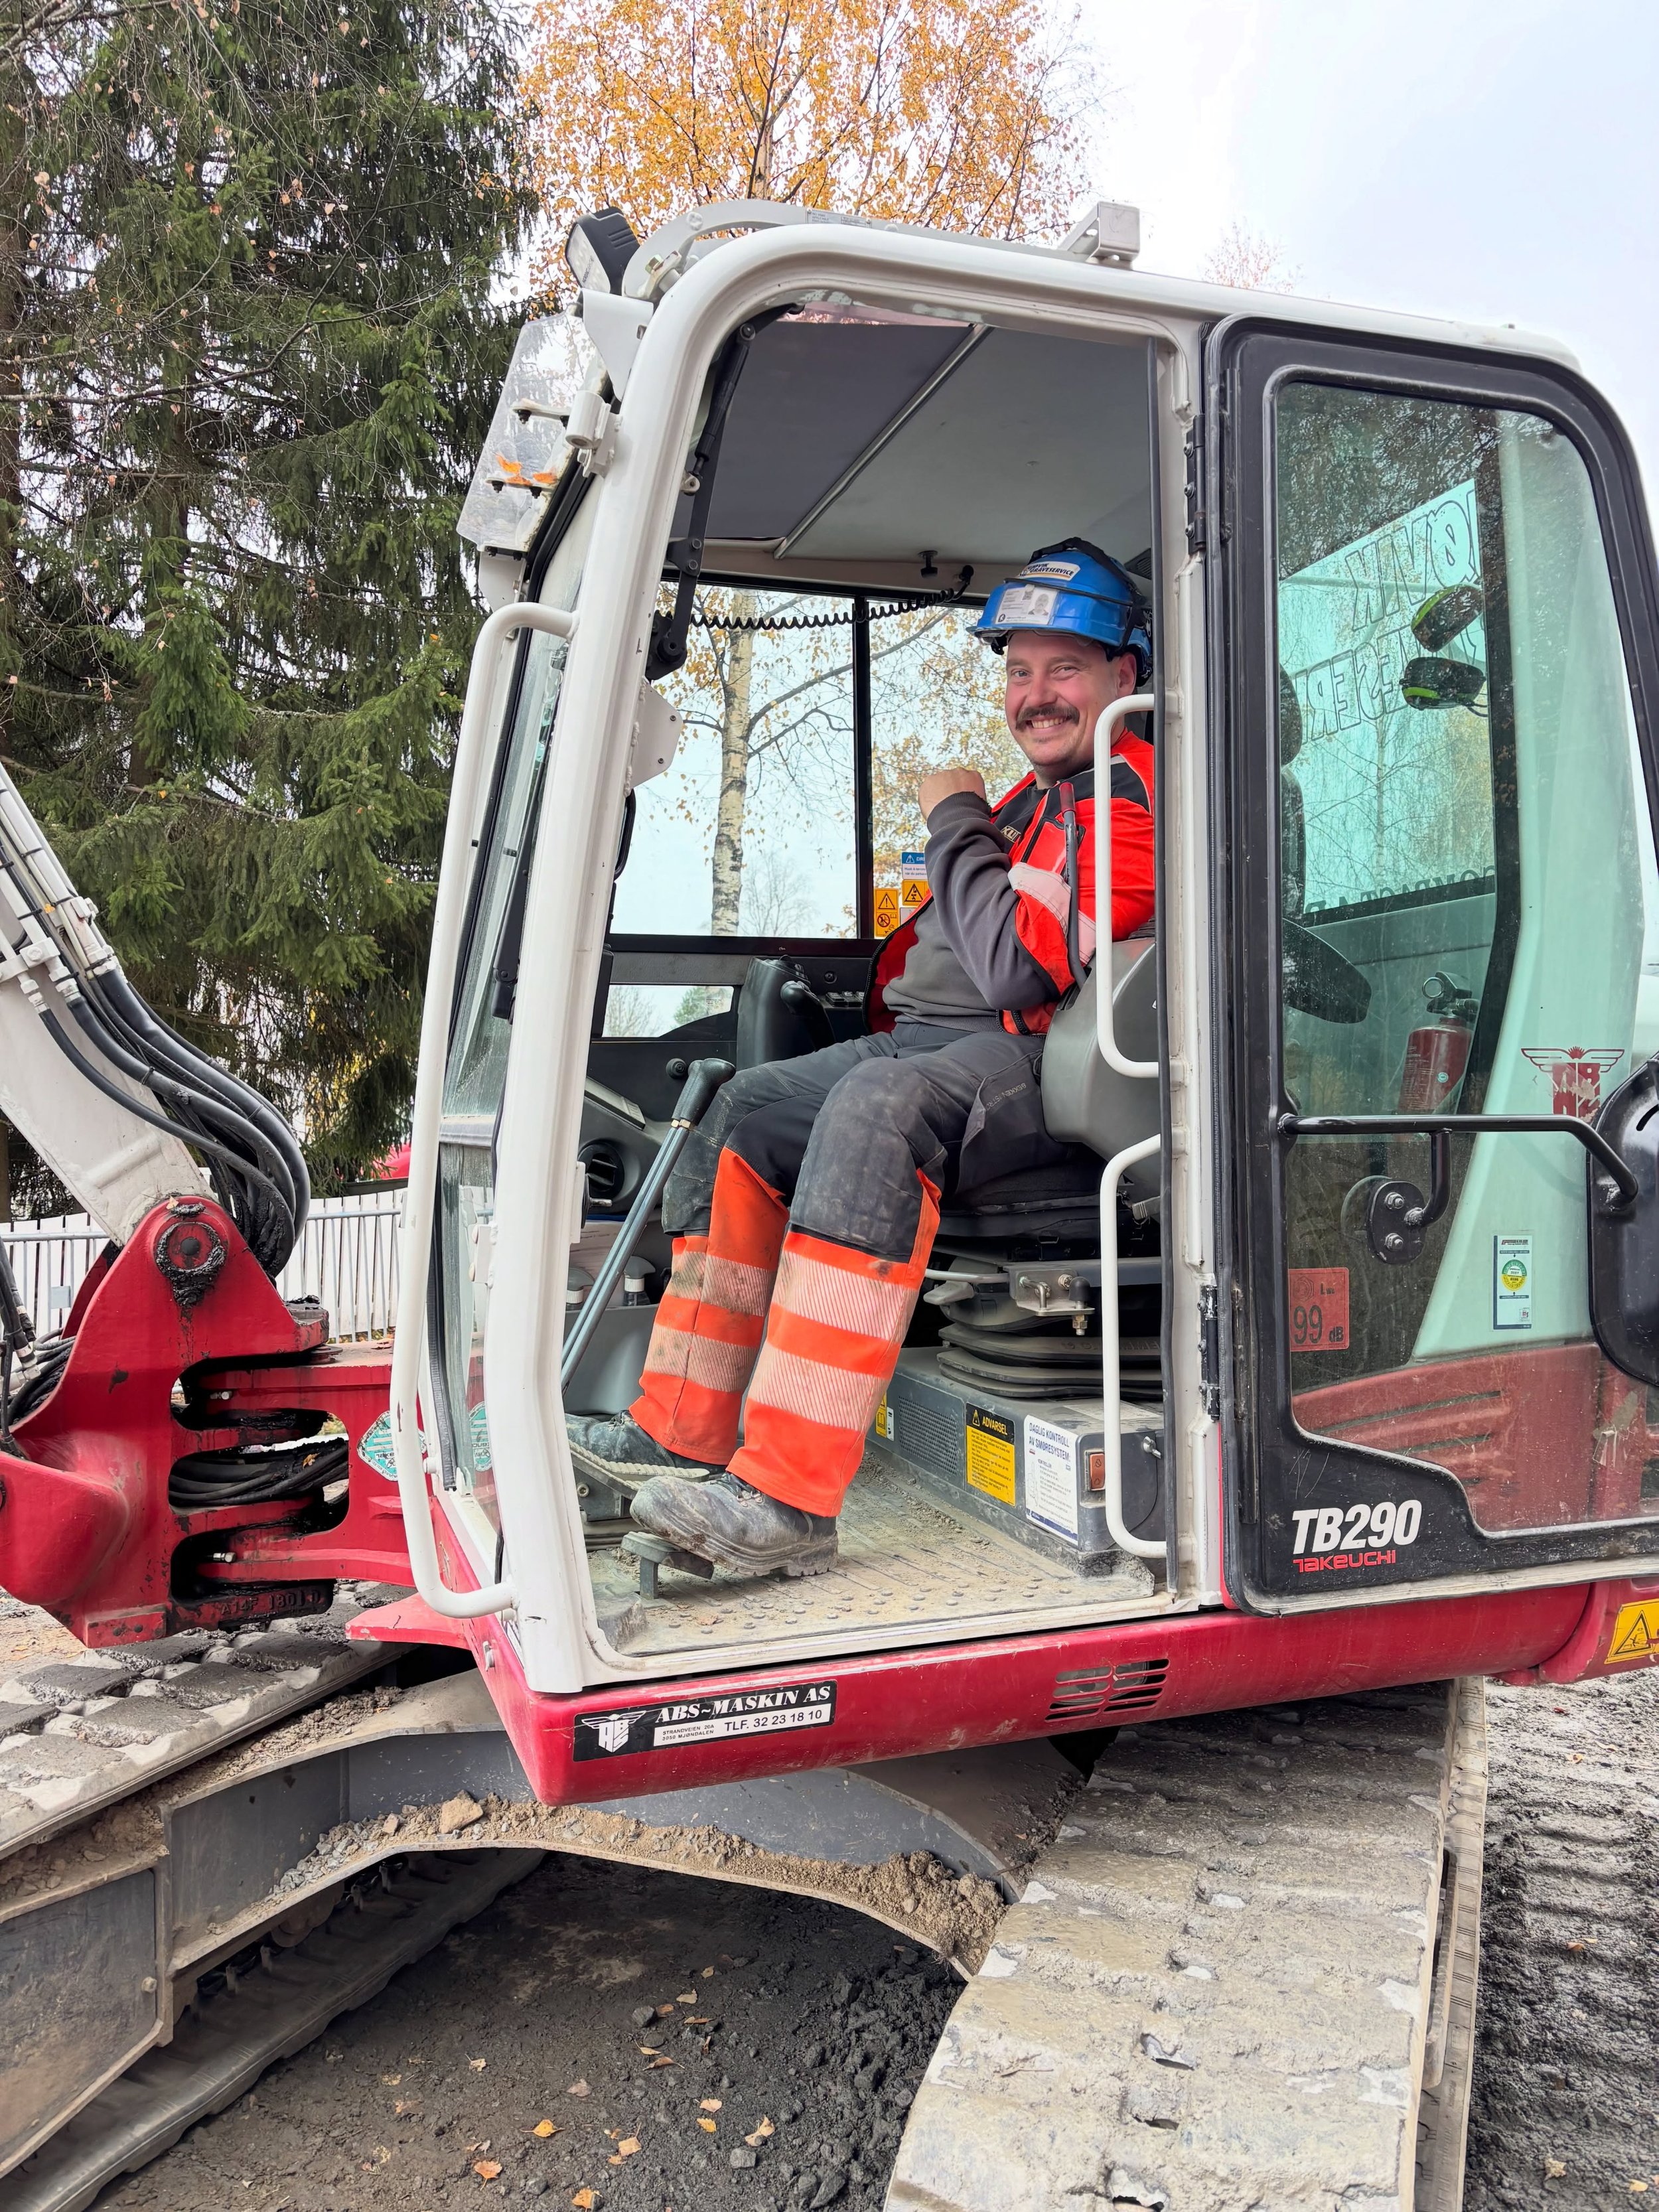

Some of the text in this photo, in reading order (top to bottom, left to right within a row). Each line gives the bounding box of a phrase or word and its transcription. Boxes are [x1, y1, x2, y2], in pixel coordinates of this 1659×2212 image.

[1030, 567, 1074, 576] GRAVESERVICE
[1293, 1305, 1344, 1344] 99 dB
[982, 1416, 1008, 1436] ADVARSEL
[1029, 1422, 1070, 1447] DAGLIG KONTROLL
[1029, 1436, 1035, 1445] AV
[1292, 1499, 1422, 1554] TB290
[804, 1686, 831, 1702] AS
[725, 1710, 822, 1732] TLF. 32 23 18 10
[663, 1726, 701, 1735] STRANDVEIEN
[678, 1730, 714, 1738] MJØNDALEN
